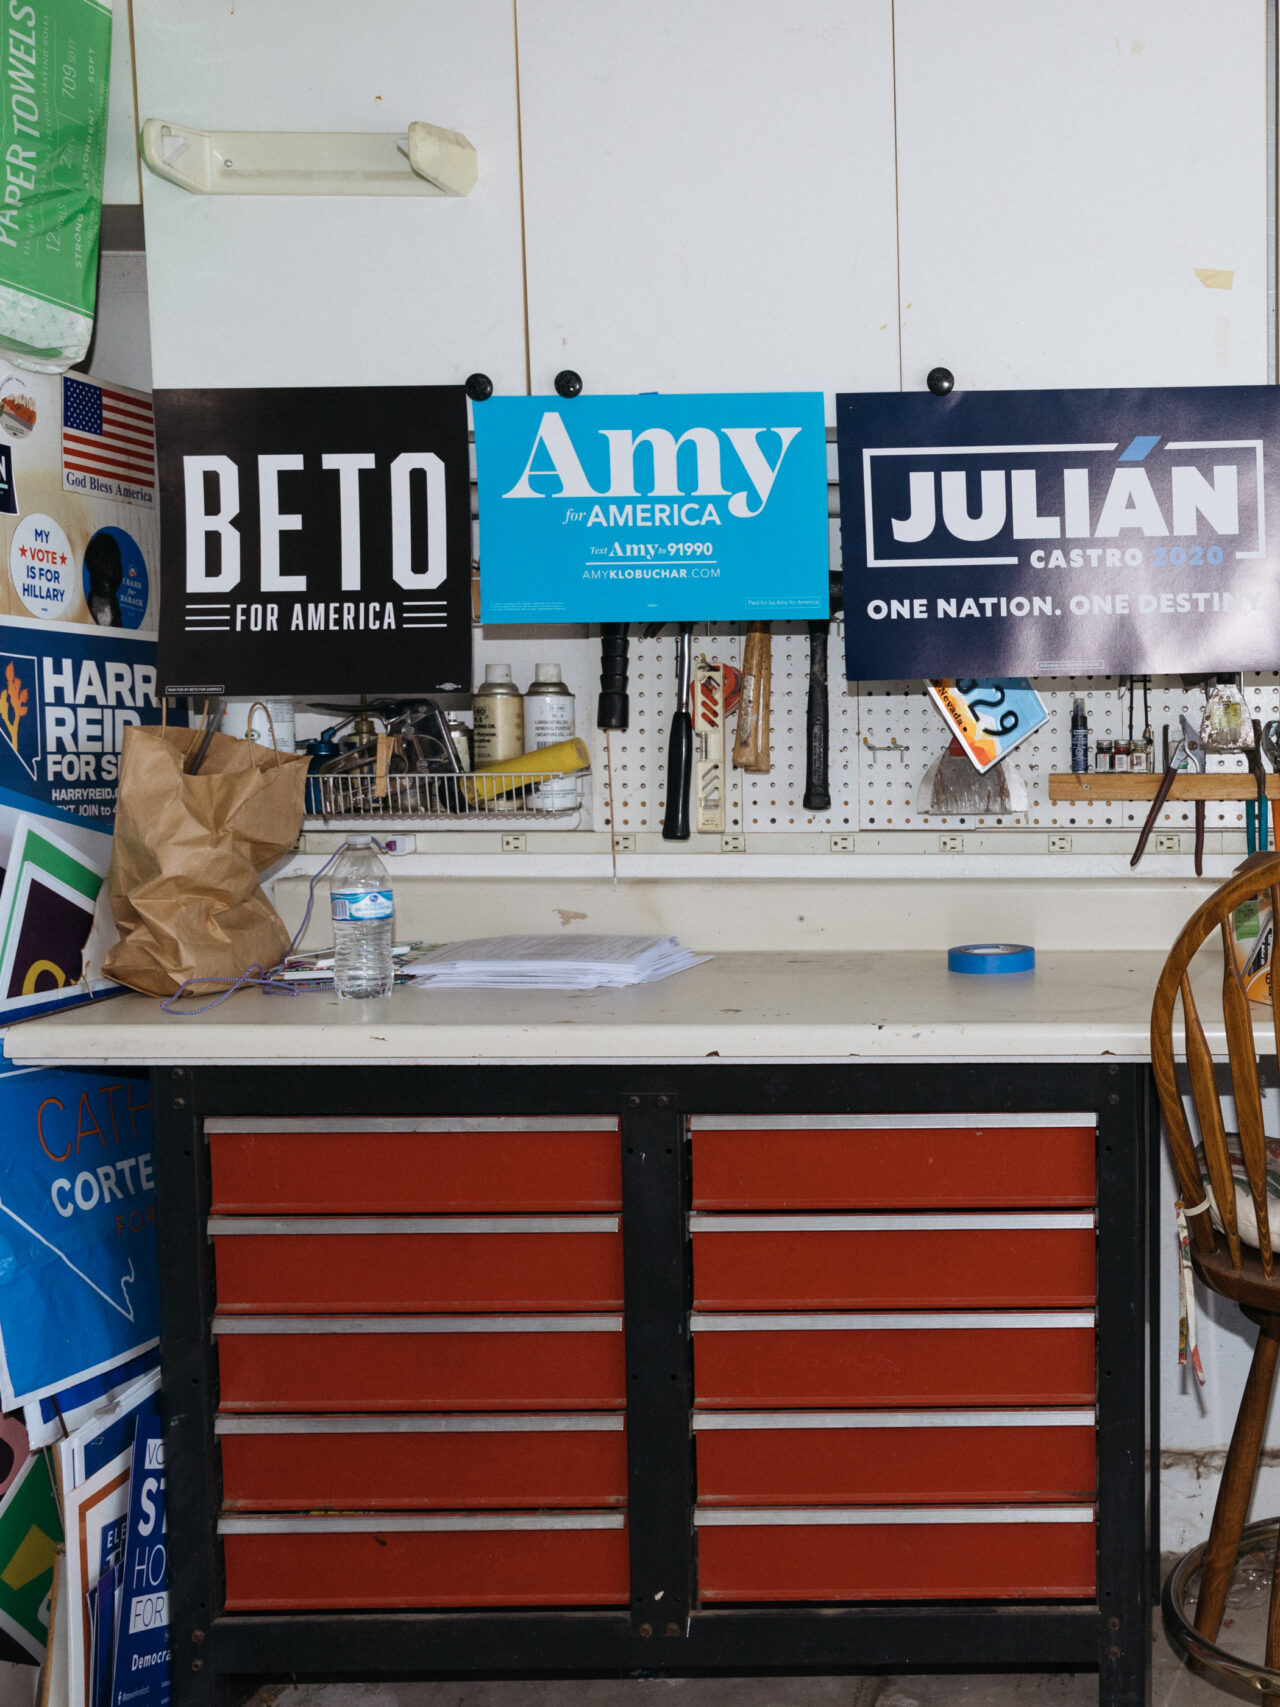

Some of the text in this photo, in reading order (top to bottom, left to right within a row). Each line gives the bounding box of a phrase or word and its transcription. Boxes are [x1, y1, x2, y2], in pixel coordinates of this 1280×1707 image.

[61, 64, 77, 100] 709
[0, 0, 39, 249] PAPER TOWELS
[59, 155, 72, 169] 2
[74, 213, 84, 268] STRONG
[88, 47, 96, 83] SOFT
[46, 231, 62, 253] 12
[502, 411, 802, 517] Amy
[66, 471, 153, 503] God Bless America
[891, 435, 1239, 543] JULIÁN
[183, 452, 448, 593] BETO
[562, 503, 721, 527] for AMERICA
[34, 528, 50, 544] MY
[29, 546, 57, 565] VOTE
[590, 545, 607, 556] Text
[609, 542, 658, 559] Amy
[668, 542, 712, 556] 91990
[1029, 545, 1224, 569] CASTRO 2020
[26, 565, 60, 584] IS FOR
[582, 568, 721, 579] AMYKLOBUCHAR.COM
[22, 582, 65, 602] HILLARY
[235, 602, 396, 631] FOR AMERICA
[867, 599, 928, 620] ONE
[937, 596, 1061, 619] NATION.
[1070, 595, 1129, 616] ONE
[42, 656, 166, 708] HARR
[937, 687, 964, 726] Nevada
[47, 755, 96, 781] FOR
[78, 805, 99, 816] JOIN
[101, 805, 111, 815] to
[37, 1082, 152, 1162] CATH
[51, 1153, 155, 1218] CORTE
[147, 1444, 165, 1468] VO
[107, 1522, 127, 1549] ELE
[133, 1544, 167, 1590] HO
[133, 1596, 165, 1630] FOR
[131, 1650, 173, 1672] Democra
